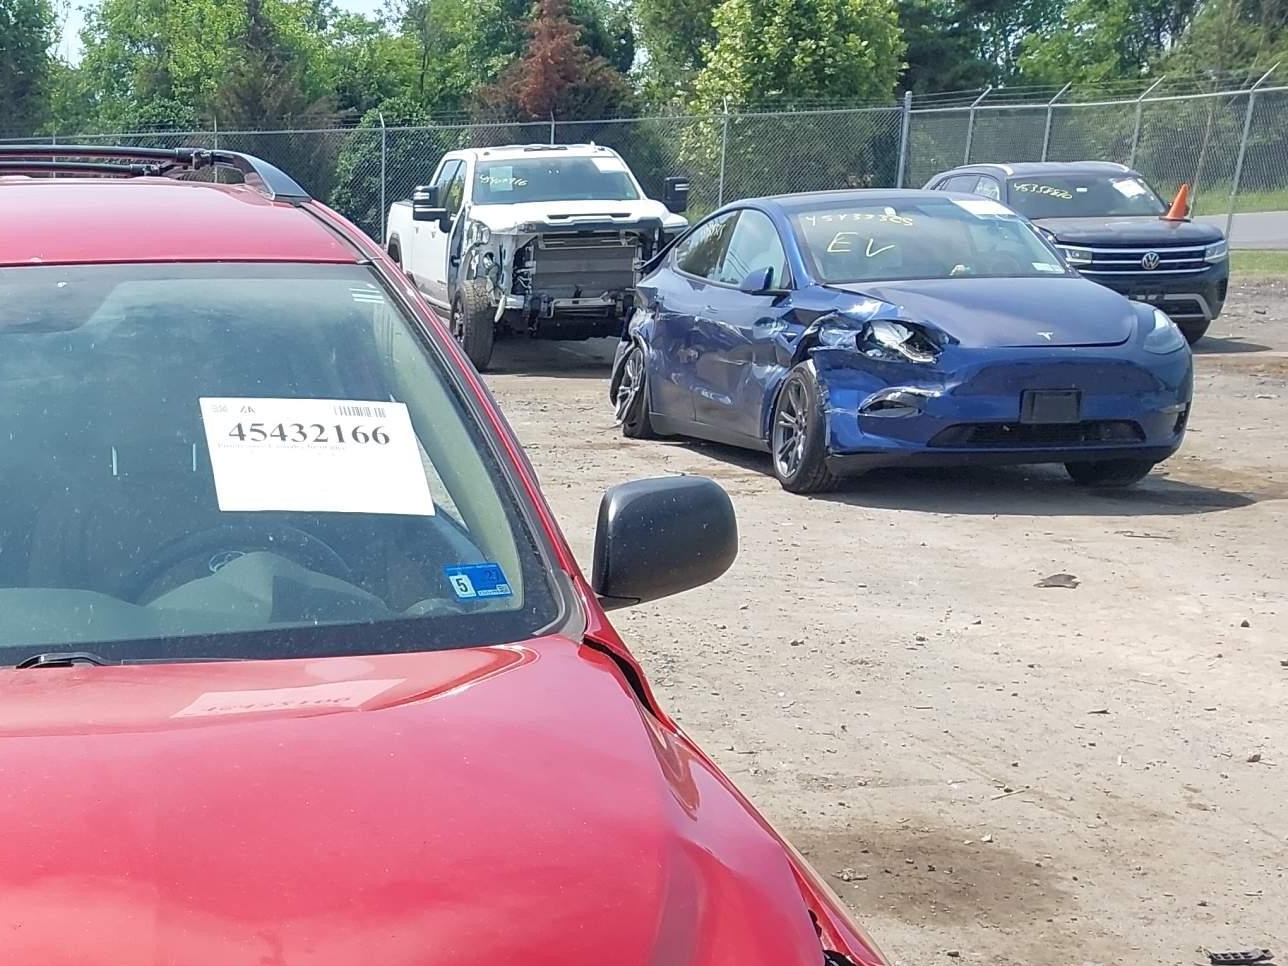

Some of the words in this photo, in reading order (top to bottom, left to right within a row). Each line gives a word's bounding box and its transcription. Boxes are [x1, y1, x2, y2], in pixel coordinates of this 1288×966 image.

[827, 231, 896, 257] EV
[228, 422, 391, 445] 45432166
[455, 577, 468, 593] 5
